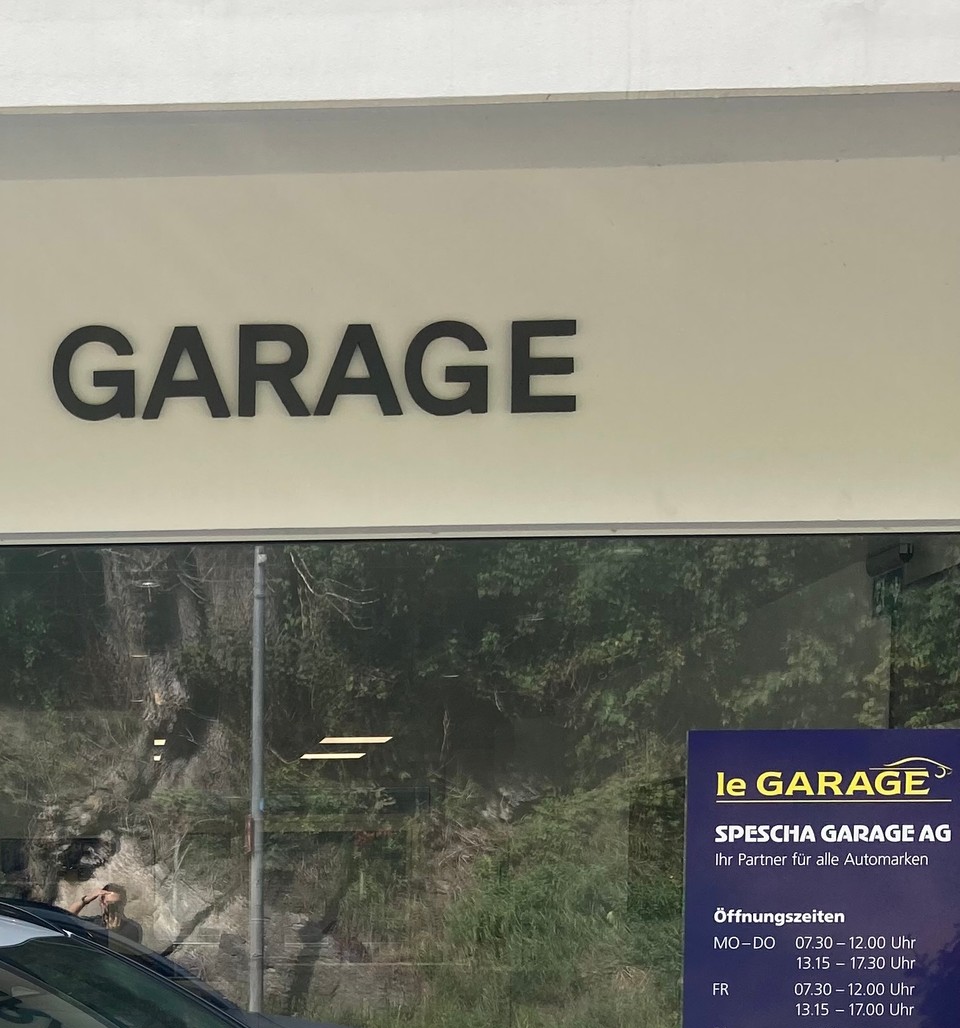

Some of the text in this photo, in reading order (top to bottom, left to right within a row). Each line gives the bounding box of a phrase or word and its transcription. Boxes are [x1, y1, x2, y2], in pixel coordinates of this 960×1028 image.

[52, 319, 577, 421] GARAGE
[716, 770, 931, 796] le GARAGE
[714, 823, 952, 843] SPESCHA GARAGE AG
[715, 851, 929, 866] Ihr Partner für alle Automarken
[713, 907, 845, 927] Öffnungszeiten
[795, 936, 833, 950] 07.30
[848, 936, 886, 950] 12.00
[891, 935, 917, 950] Uhr
[796, 956, 830, 970] 13.15
[850, 956, 886, 970] 17.30
[890, 955, 916, 970] Uhr
[712, 982, 729, 996] FR
[794, 982, 832, 996] 07.30
[847, 982, 885, 996] 12.00
[890, 981, 915, 996] Uhr
[795, 1002, 829, 1016] 13.15
[848, 1002, 885, 1016] 17.00
[889, 1002, 915, 1016] Uhr
